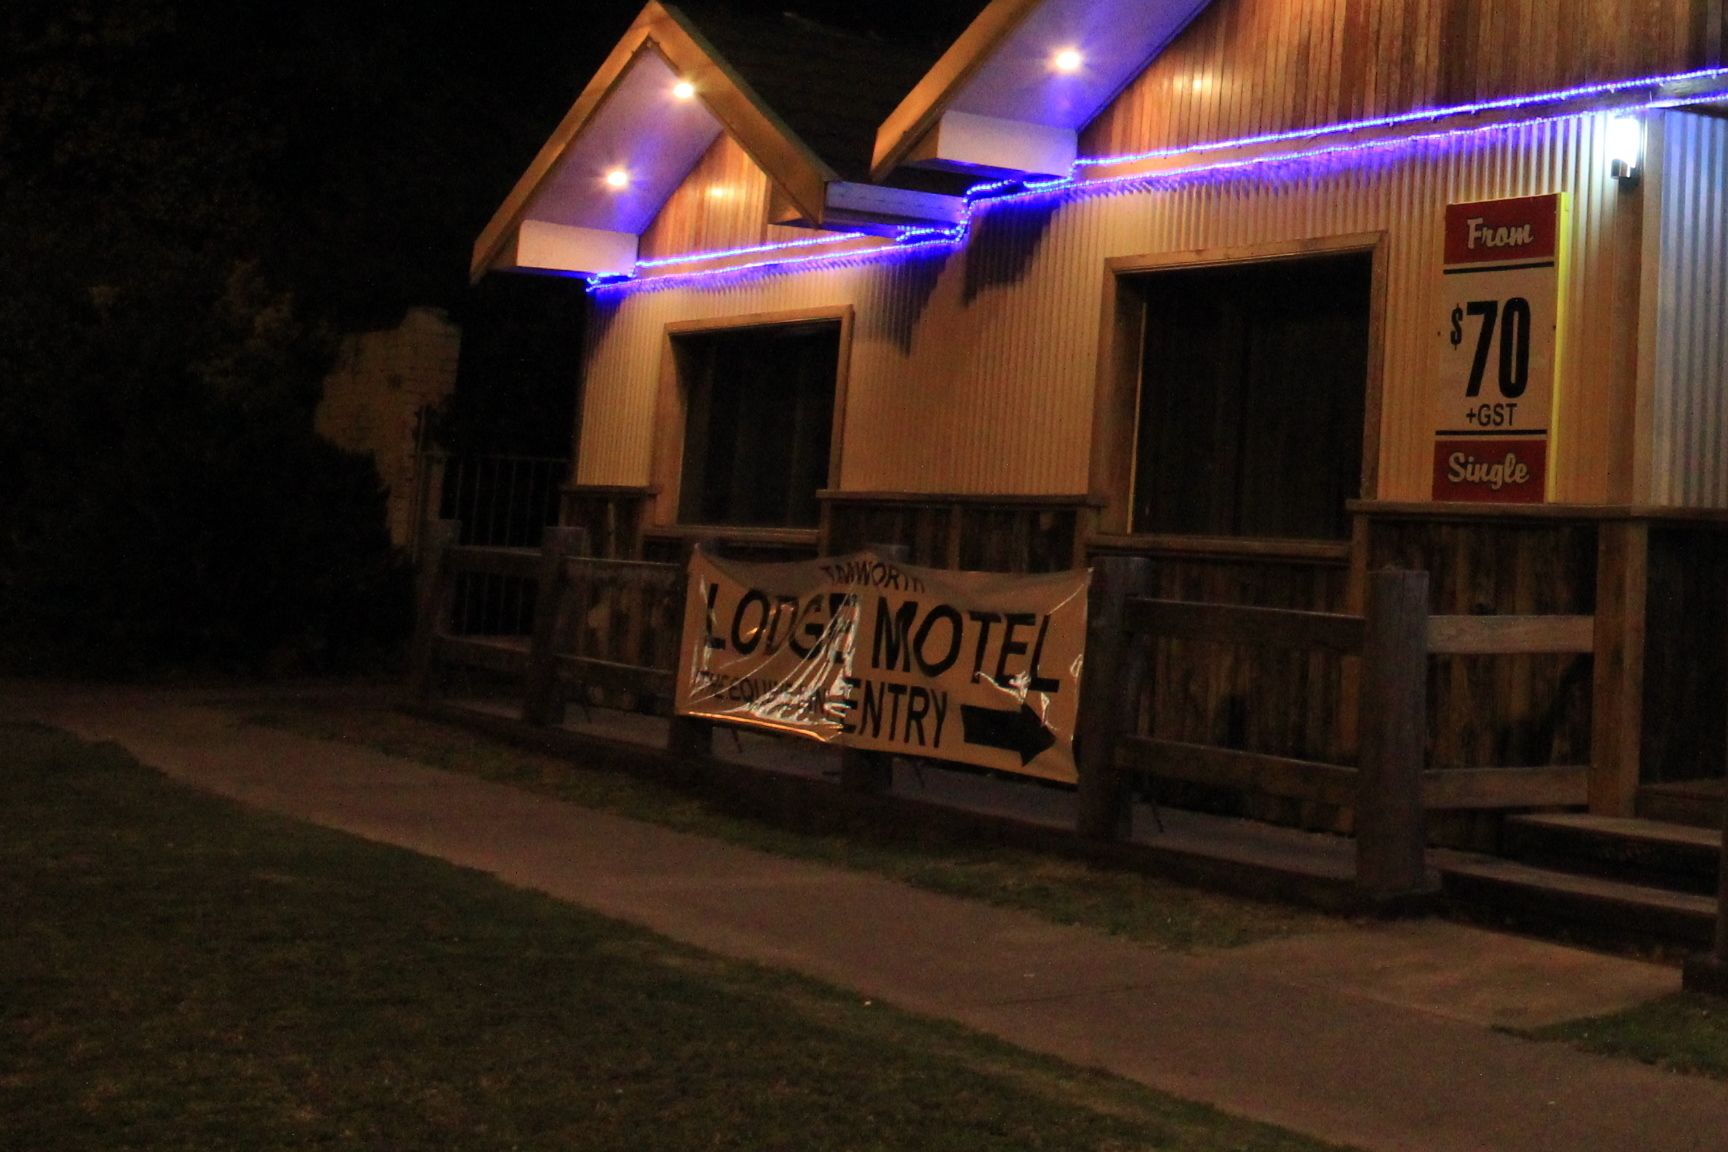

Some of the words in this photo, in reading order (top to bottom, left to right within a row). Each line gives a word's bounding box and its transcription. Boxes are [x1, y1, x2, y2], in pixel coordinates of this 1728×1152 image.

[1466, 217, 1535, 249] From
[1450, 297, 1531, 398] $70
[1465, 402, 1518, 427] +GST
[1448, 451, 1530, 490] Single
[871, 596, 1061, 694] MOTEL
[838, 677, 949, 749] ENTRY
